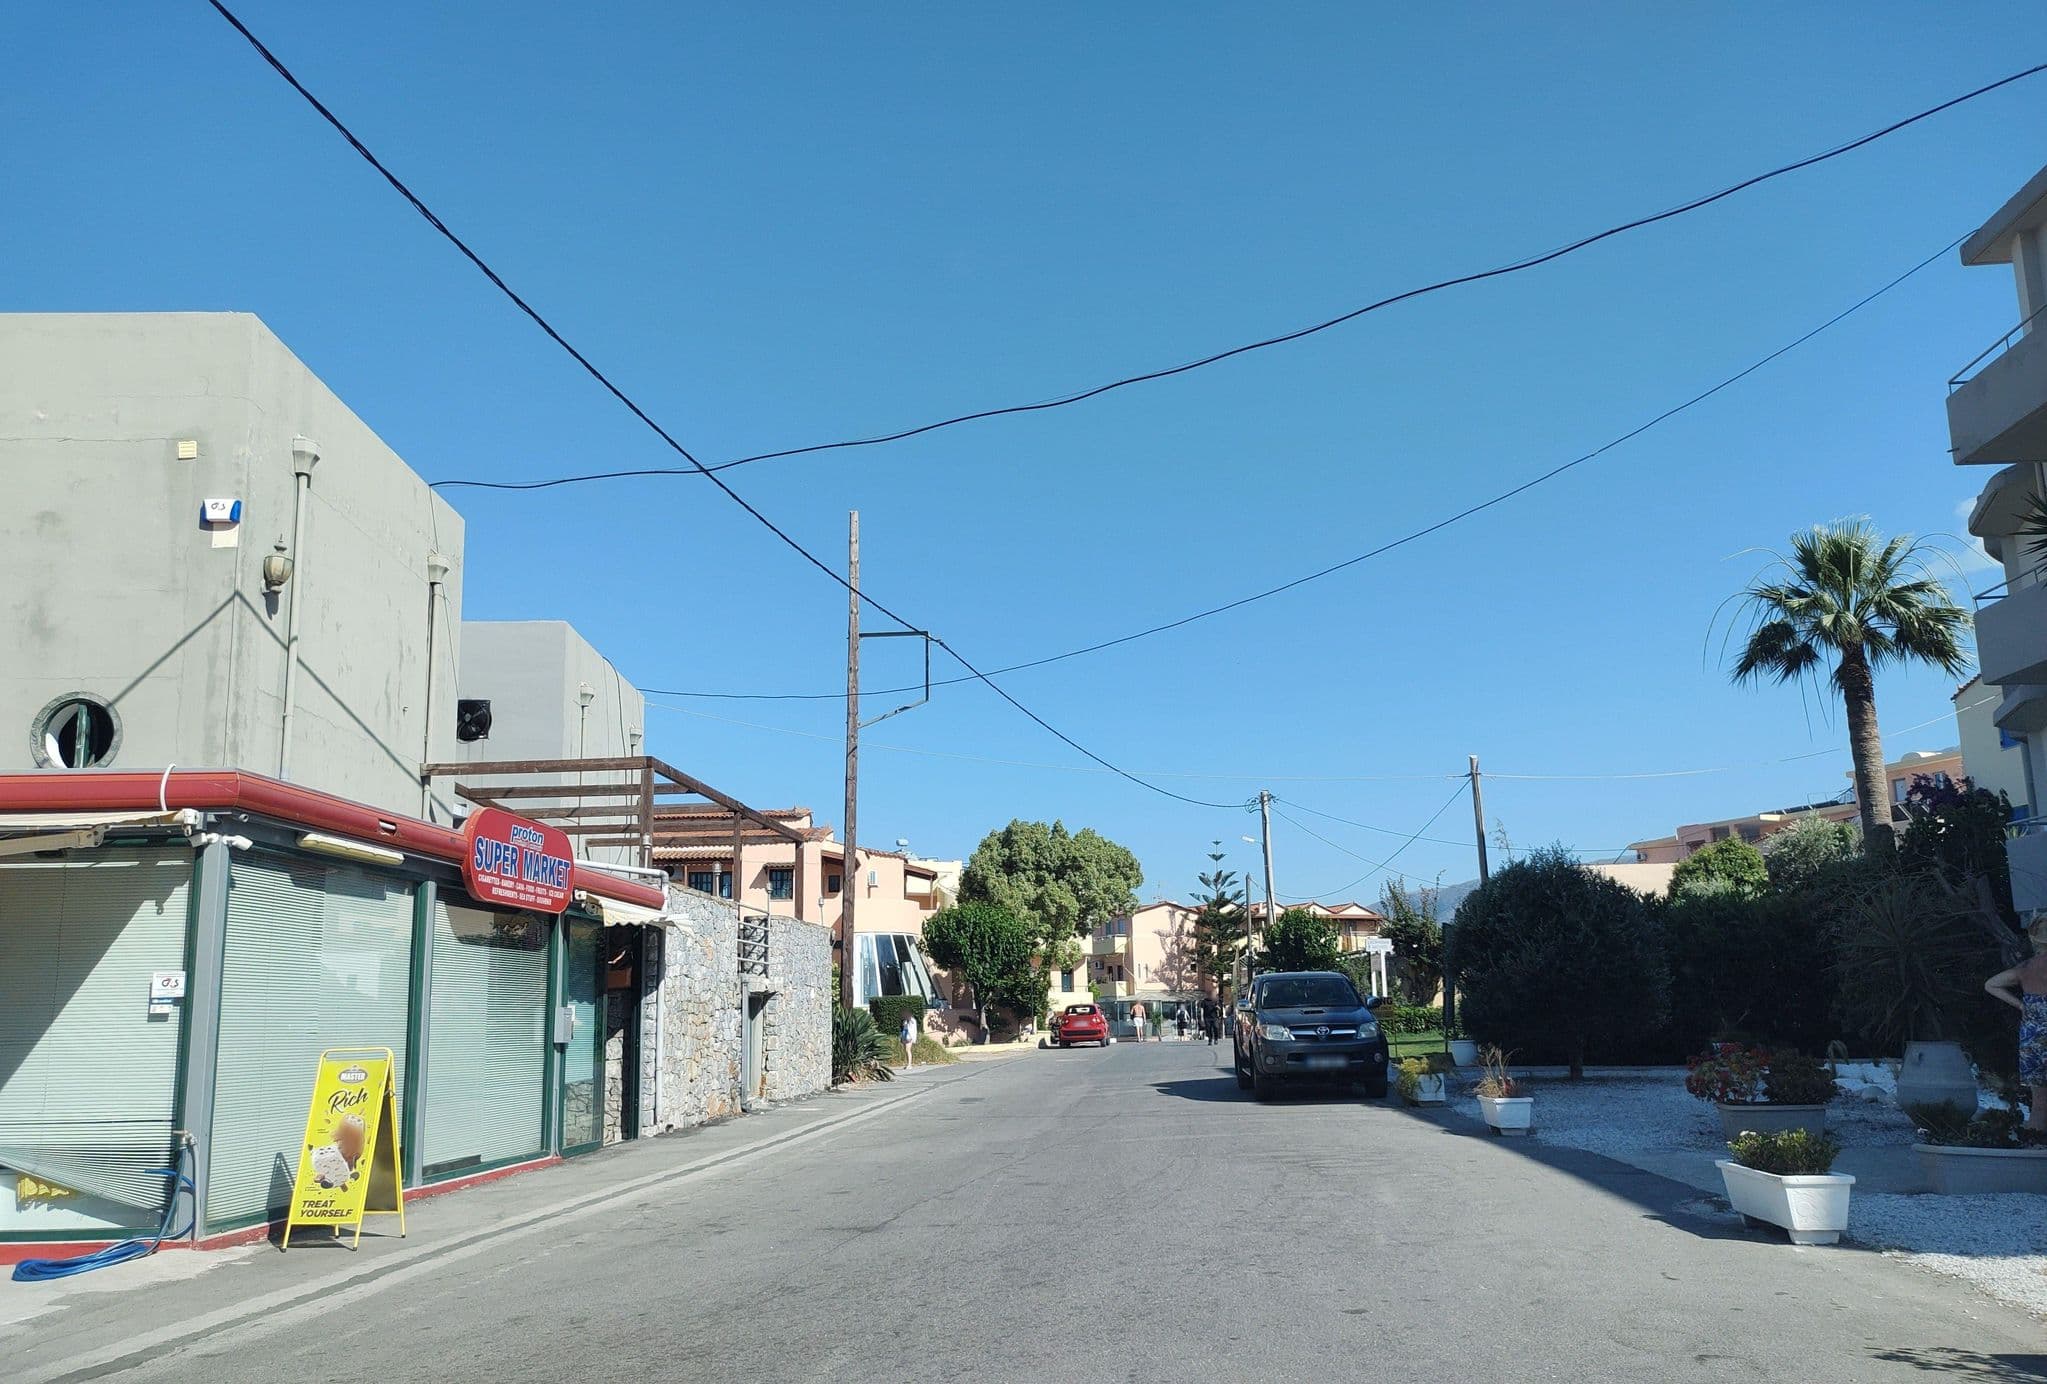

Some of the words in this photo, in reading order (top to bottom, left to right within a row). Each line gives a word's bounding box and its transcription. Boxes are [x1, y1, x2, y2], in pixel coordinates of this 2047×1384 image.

[511, 825, 544, 845] proton
[475, 836, 518, 878] SUPER
[522, 849, 570, 890] MARKET
[340, 1071, 366, 1081] MASTER
[328, 1087, 368, 1114] Rich
[302, 1200, 336, 1208] TREAT
[299, 1208, 353, 1218] YOURSELF
